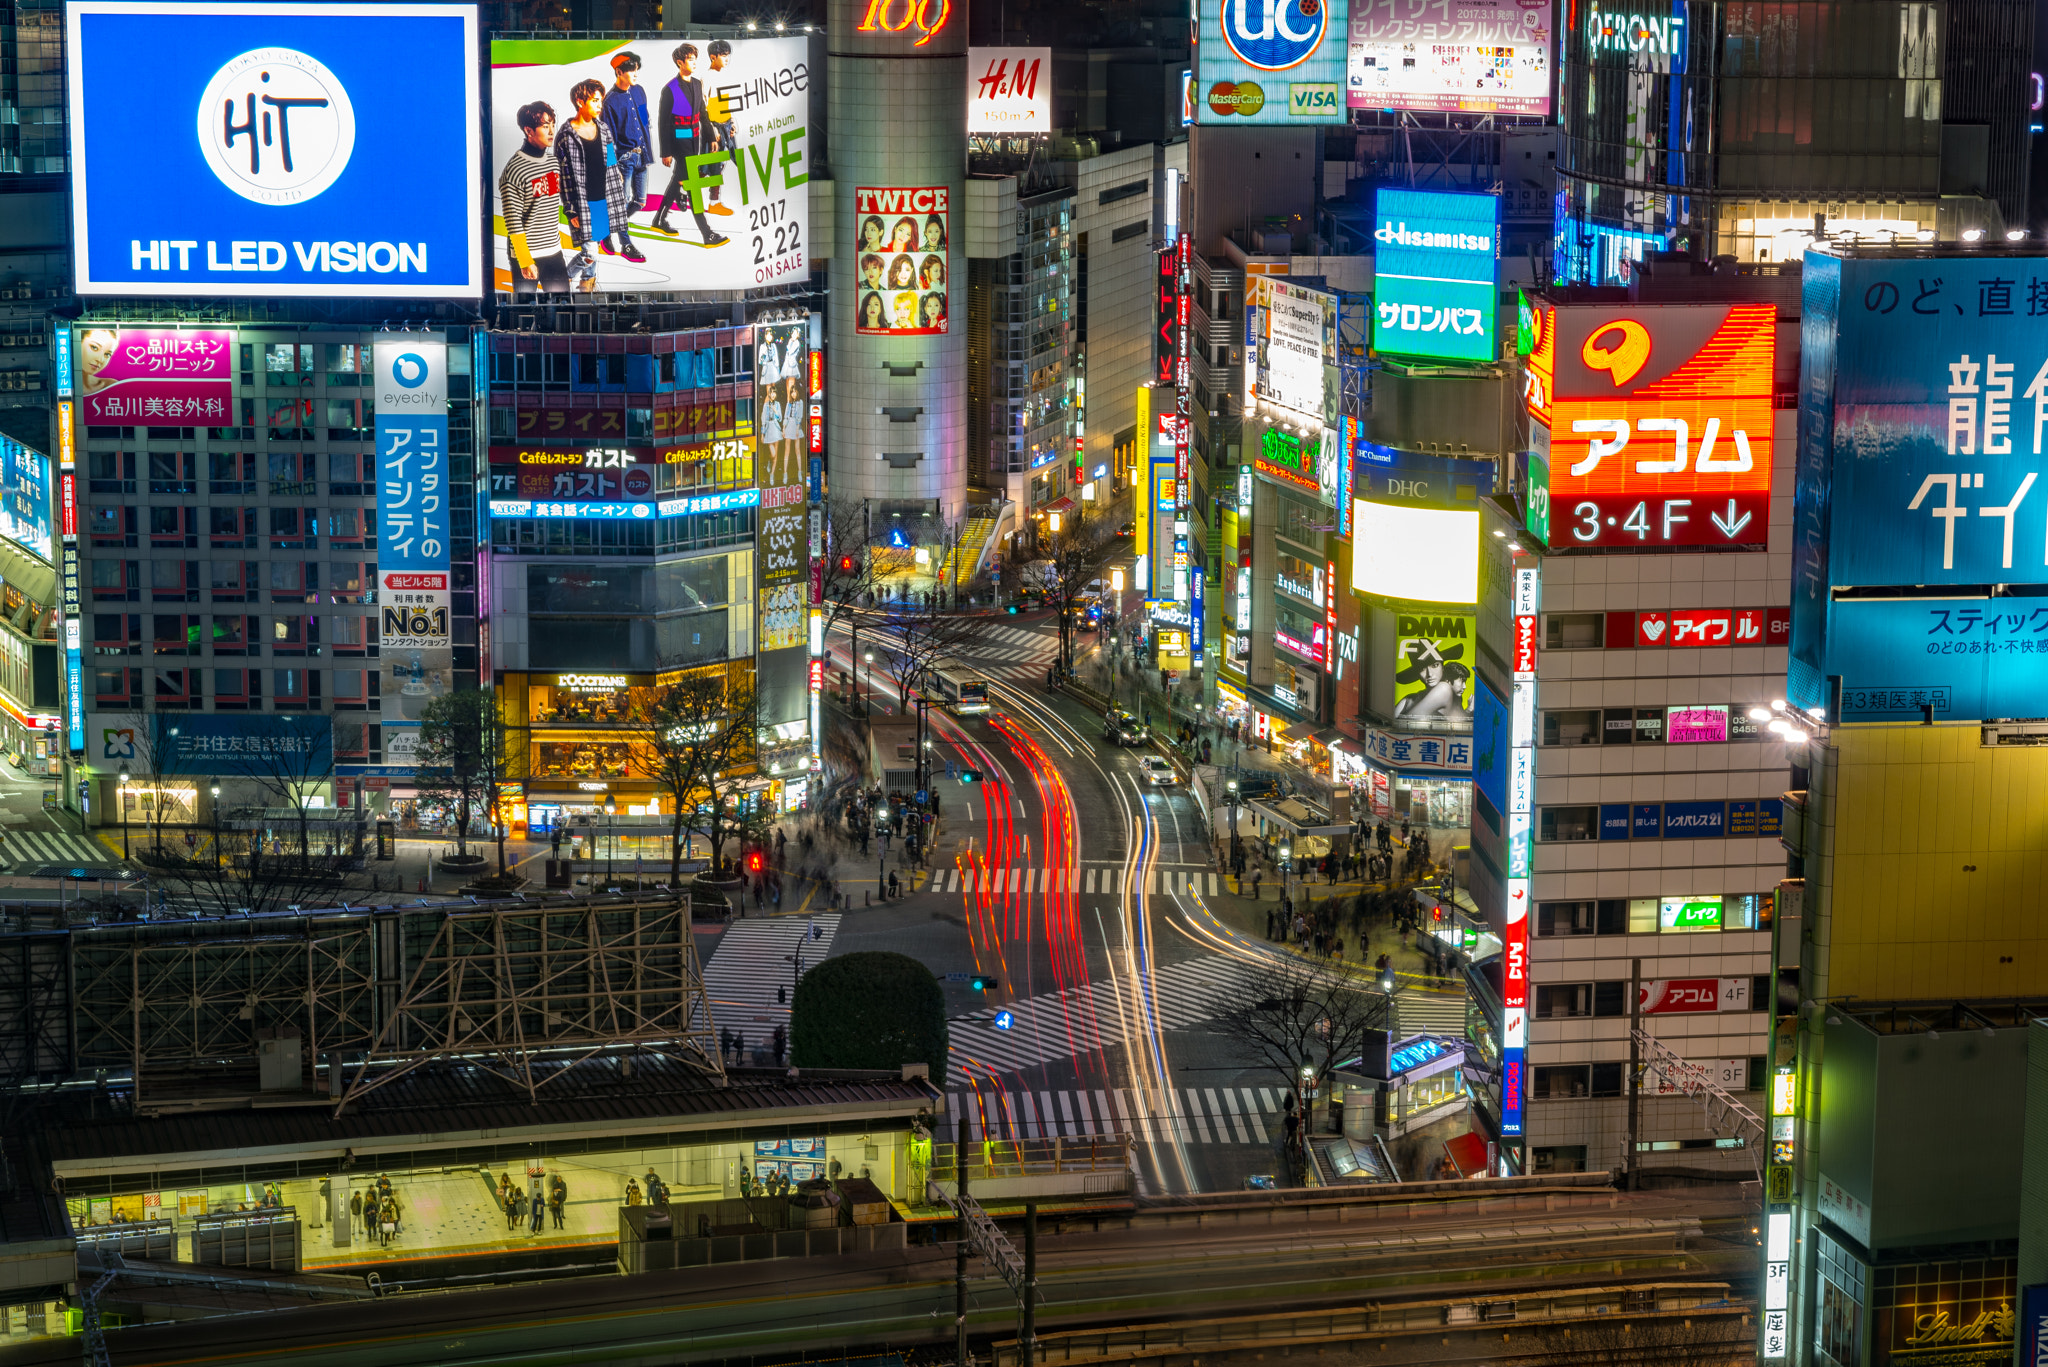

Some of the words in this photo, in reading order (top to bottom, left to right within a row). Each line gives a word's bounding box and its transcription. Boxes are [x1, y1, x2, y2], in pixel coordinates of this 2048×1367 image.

[1350, 17, 1530, 43] セレクションアルバム
[977, 57, 1041, 101] H&M
[1209, 93, 1264, 105] MasterCard
[1294, 91, 1337, 108] VISA
[749, 123, 765, 138] 5th
[767, 113, 796, 132] Album
[682, 125, 809, 215] FIVE
[857, 189, 947, 213] TWICE
[749, 199, 787, 232] 2017
[751, 221, 802, 265] 2.22
[1374, 221, 1490, 251] Hisamitsu
[131, 239, 198, 271] HIT
[207, 241, 287, 272] LED
[293, 242, 428, 273] VISION
[755, 265, 774, 284] ON
[774, 252, 803, 278] SALE
[1378, 302, 1485, 337] サロンパス
[146, 337, 224, 356] 品川スキン
[147, 355, 217, 373] クリニック
[384, 391, 438, 407] eyecity
[1524, 366, 1545, 409] アコム
[104, 397, 225, 418] 品川美容外科
[518, 409, 623, 433] プライス
[654, 403, 733, 430] コンタクト
[711, 439, 750, 462] ガスト
[1356, 448, 1368, 458] DHC
[1369, 450, 1392, 463] Channel
[1570, 416, 1754, 477] アコム
[585, 448, 637, 469] ガスト
[491, 475, 517, 491] 7F
[522, 474, 550, 487] Café
[552, 471, 617, 498] ガスト
[627, 480, 649, 489] ガスト
[1387, 477, 1429, 499] DHC
[384, 428, 415, 559] アイシティ
[420, 428, 442, 558] コンタクトの
[689, 493, 758, 513] 英会話イーオン
[761, 484, 803, 509] HKT48
[1529, 475, 1549, 520] レイク
[494, 504, 527, 516] AEON
[535, 503, 628, 517] 英会話イーオン
[762, 515, 803, 535] バグって
[769, 533, 796, 550] いい
[767, 550, 798, 570] じゃん
[64, 550, 78, 602] 加藤眼科
[391, 575, 443, 588] 当ビル5階
[1277, 573, 1313, 600] Euphoria
[394, 594, 435, 603] 利用者数
[381, 605, 449, 637] No.1
[1398, 615, 1468, 639] DMM
[1672, 617, 1760, 641] アイフル
[382, 638, 450, 647] コンタクトショップ
[1397, 638, 1444, 661] FX
[1518, 629, 1532, 672] アイフル
[558, 673, 627, 686] L'OCCITANE
[70, 668, 81, 732] 三井住友信託銀行
[1671, 709, 1726, 723] ブランド品
[1671, 728, 1722, 741] 高価買取
[1732, 725, 1758, 734] 6455
[176, 735, 312, 753] 三井住友信託銀行
[1367, 731, 1470, 765] 大盛堂書店
[1666, 812, 1722, 827] レオパレス21
[1511, 838, 1526, 875] レイク
[1685, 907, 1718, 921] レイク
[1508, 941, 1525, 980] アコム
[1669, 988, 1714, 1004] アコム
[1725, 987, 1746, 1001] 4F
[1507, 1062, 1519, 1111] PROMISE
[1722, 1068, 1743, 1082] 3F
[1769, 1264, 1787, 1278] 3F
[1905, 1311, 1995, 1345] Lindt
[1928, 1350, 1992, 1364] CHOCOLATIER
